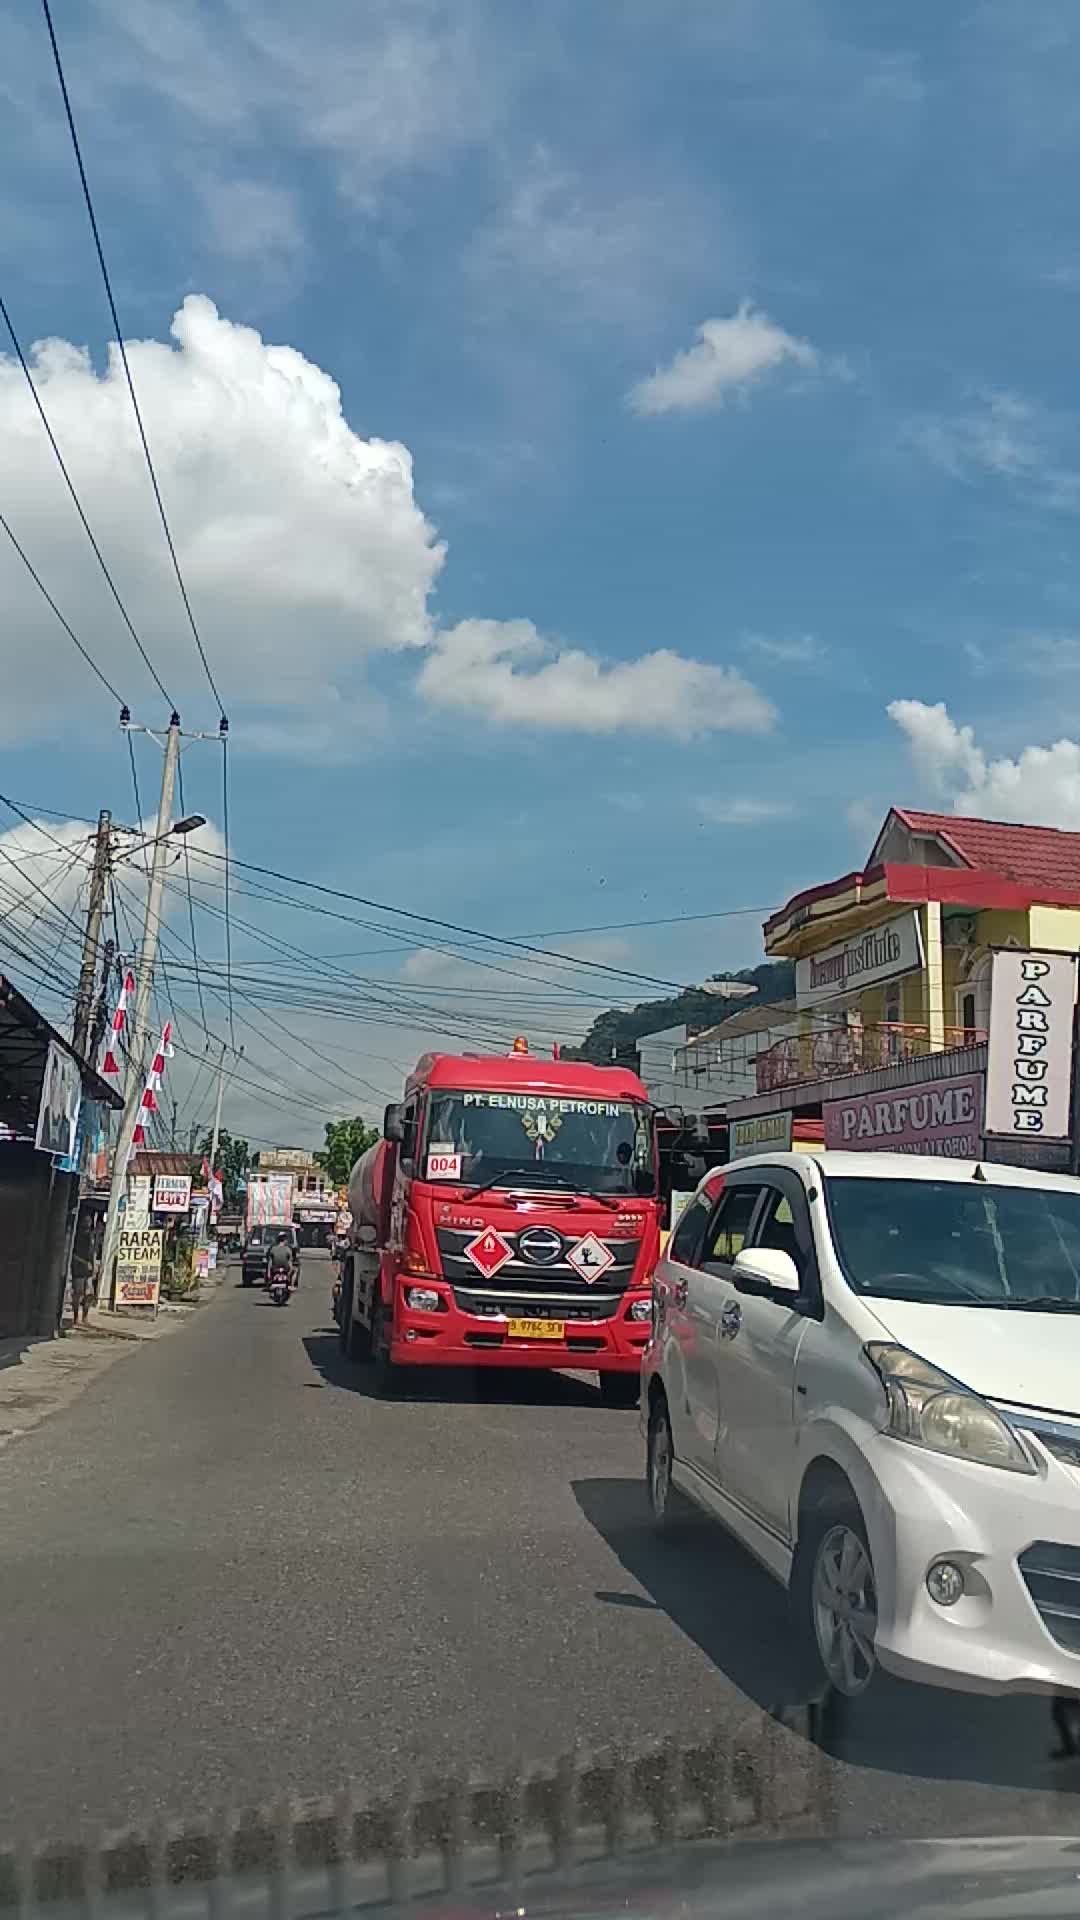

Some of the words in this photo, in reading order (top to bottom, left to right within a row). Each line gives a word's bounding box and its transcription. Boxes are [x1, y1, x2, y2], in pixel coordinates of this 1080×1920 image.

[1012, 960, 1050, 1131] PARFUME
[463, 1093, 485, 1107] PT.
[488, 1095, 546, 1111] ELNUSA
[549, 1100, 620, 1117] PETROFIN
[841, 1088, 975, 1141] PARFUME
[431, 1158, 457, 1171] 004
[440, 1215, 484, 1227] HINO
[120, 1231, 160, 1247] RARA
[119, 1247, 160, 1261] STEAM
